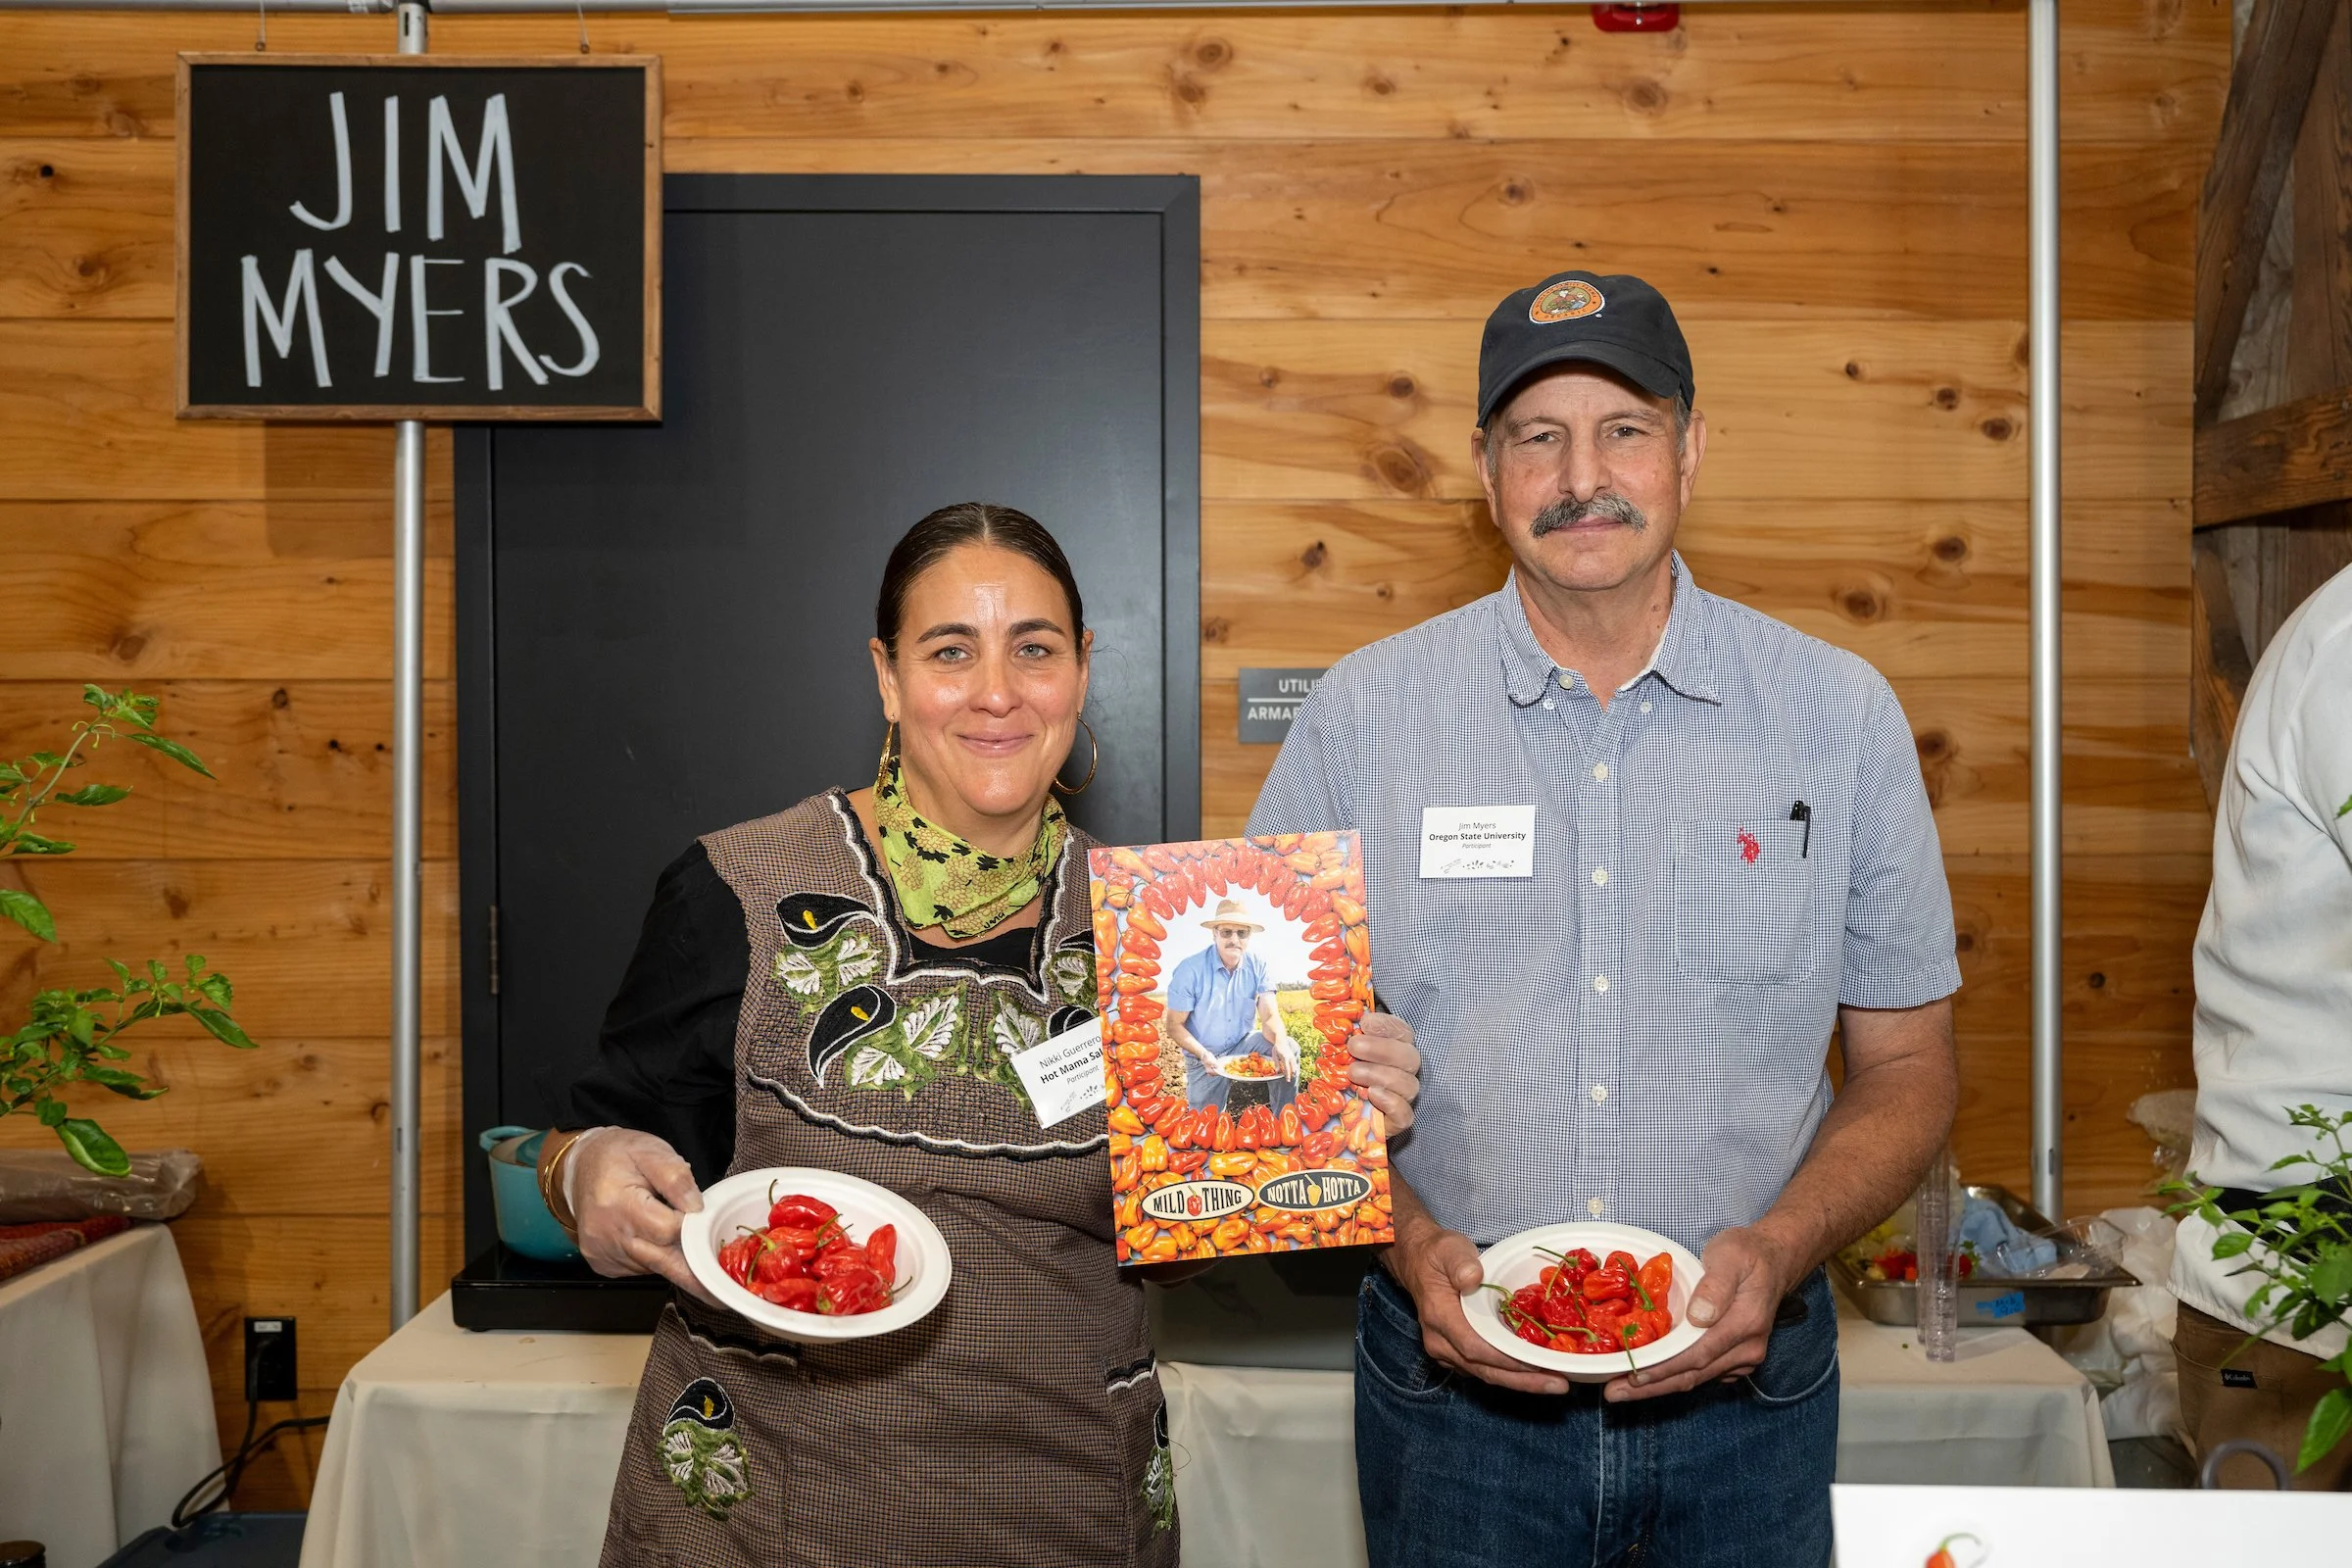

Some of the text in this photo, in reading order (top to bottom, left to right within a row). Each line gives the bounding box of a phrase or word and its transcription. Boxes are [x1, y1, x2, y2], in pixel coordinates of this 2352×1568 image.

[289, 92, 522, 254] JIM
[241, 248, 600, 391] MYERS
[1429, 833, 1458, 842] Oregon
[1484, 831, 1527, 841] University
[1473, 822, 1496, 831] Myers
[1040, 1035, 1102, 1069] Nikki Guerrero
[1040, 1070, 1059, 1084] Hot
[1059, 1056, 1089, 1075] Mama
[1066, 1064, 1100, 1085] Participant
[1152, 1186, 1242, 1214] MILD THING
[1266, 1176, 1361, 1205] NOTTA HOTTA
